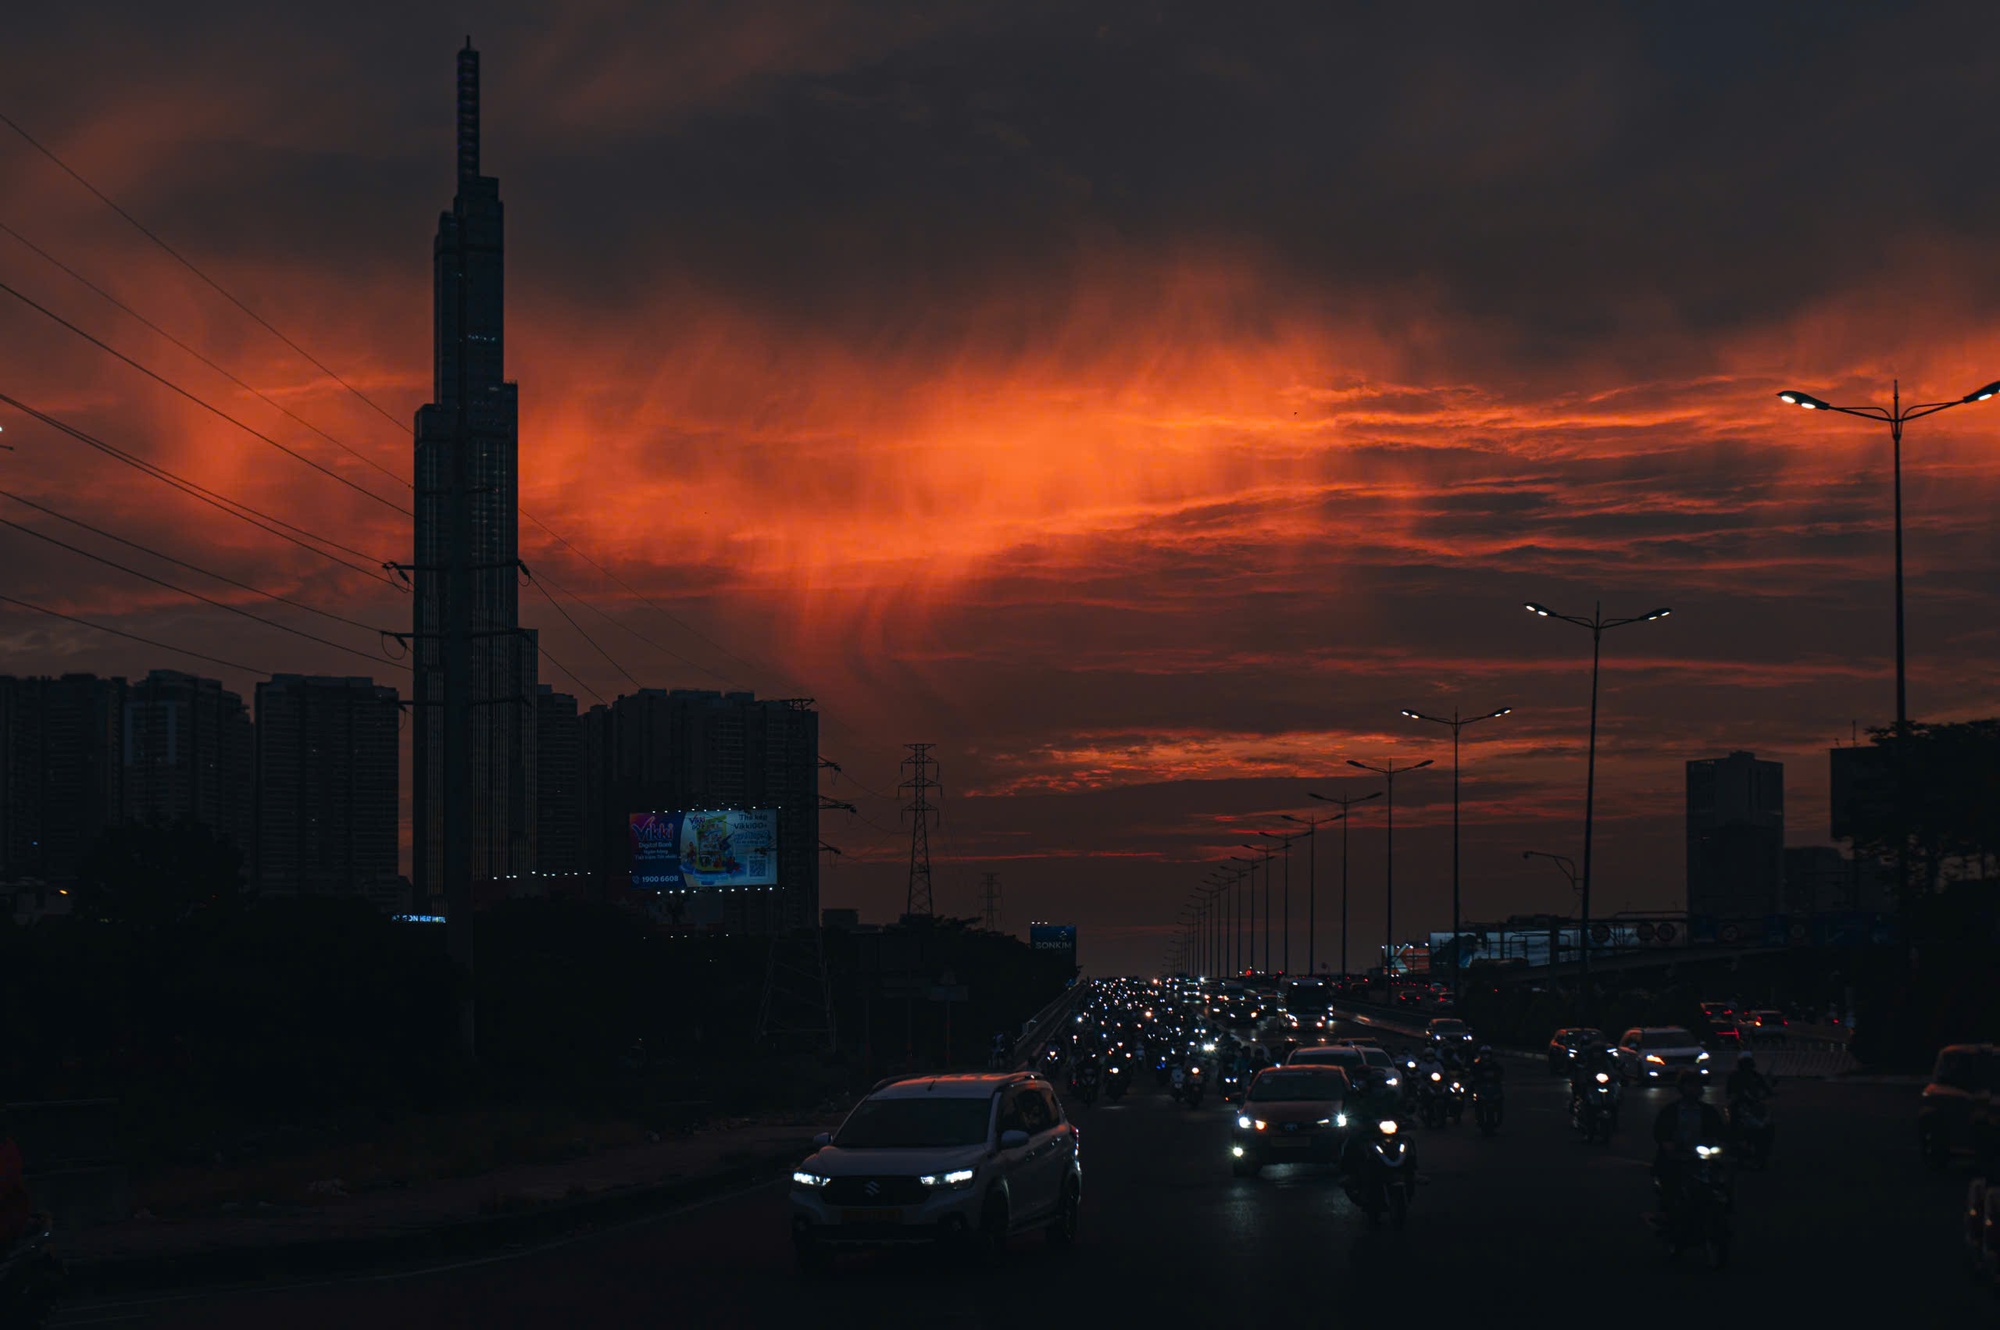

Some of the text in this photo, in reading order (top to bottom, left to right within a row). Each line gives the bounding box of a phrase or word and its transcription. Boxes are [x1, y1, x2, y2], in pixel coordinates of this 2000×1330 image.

[631, 816, 674, 841] Vikki
[638, 841, 657, 849] Digital
[1035, 941, 1072, 949] SONKIM
